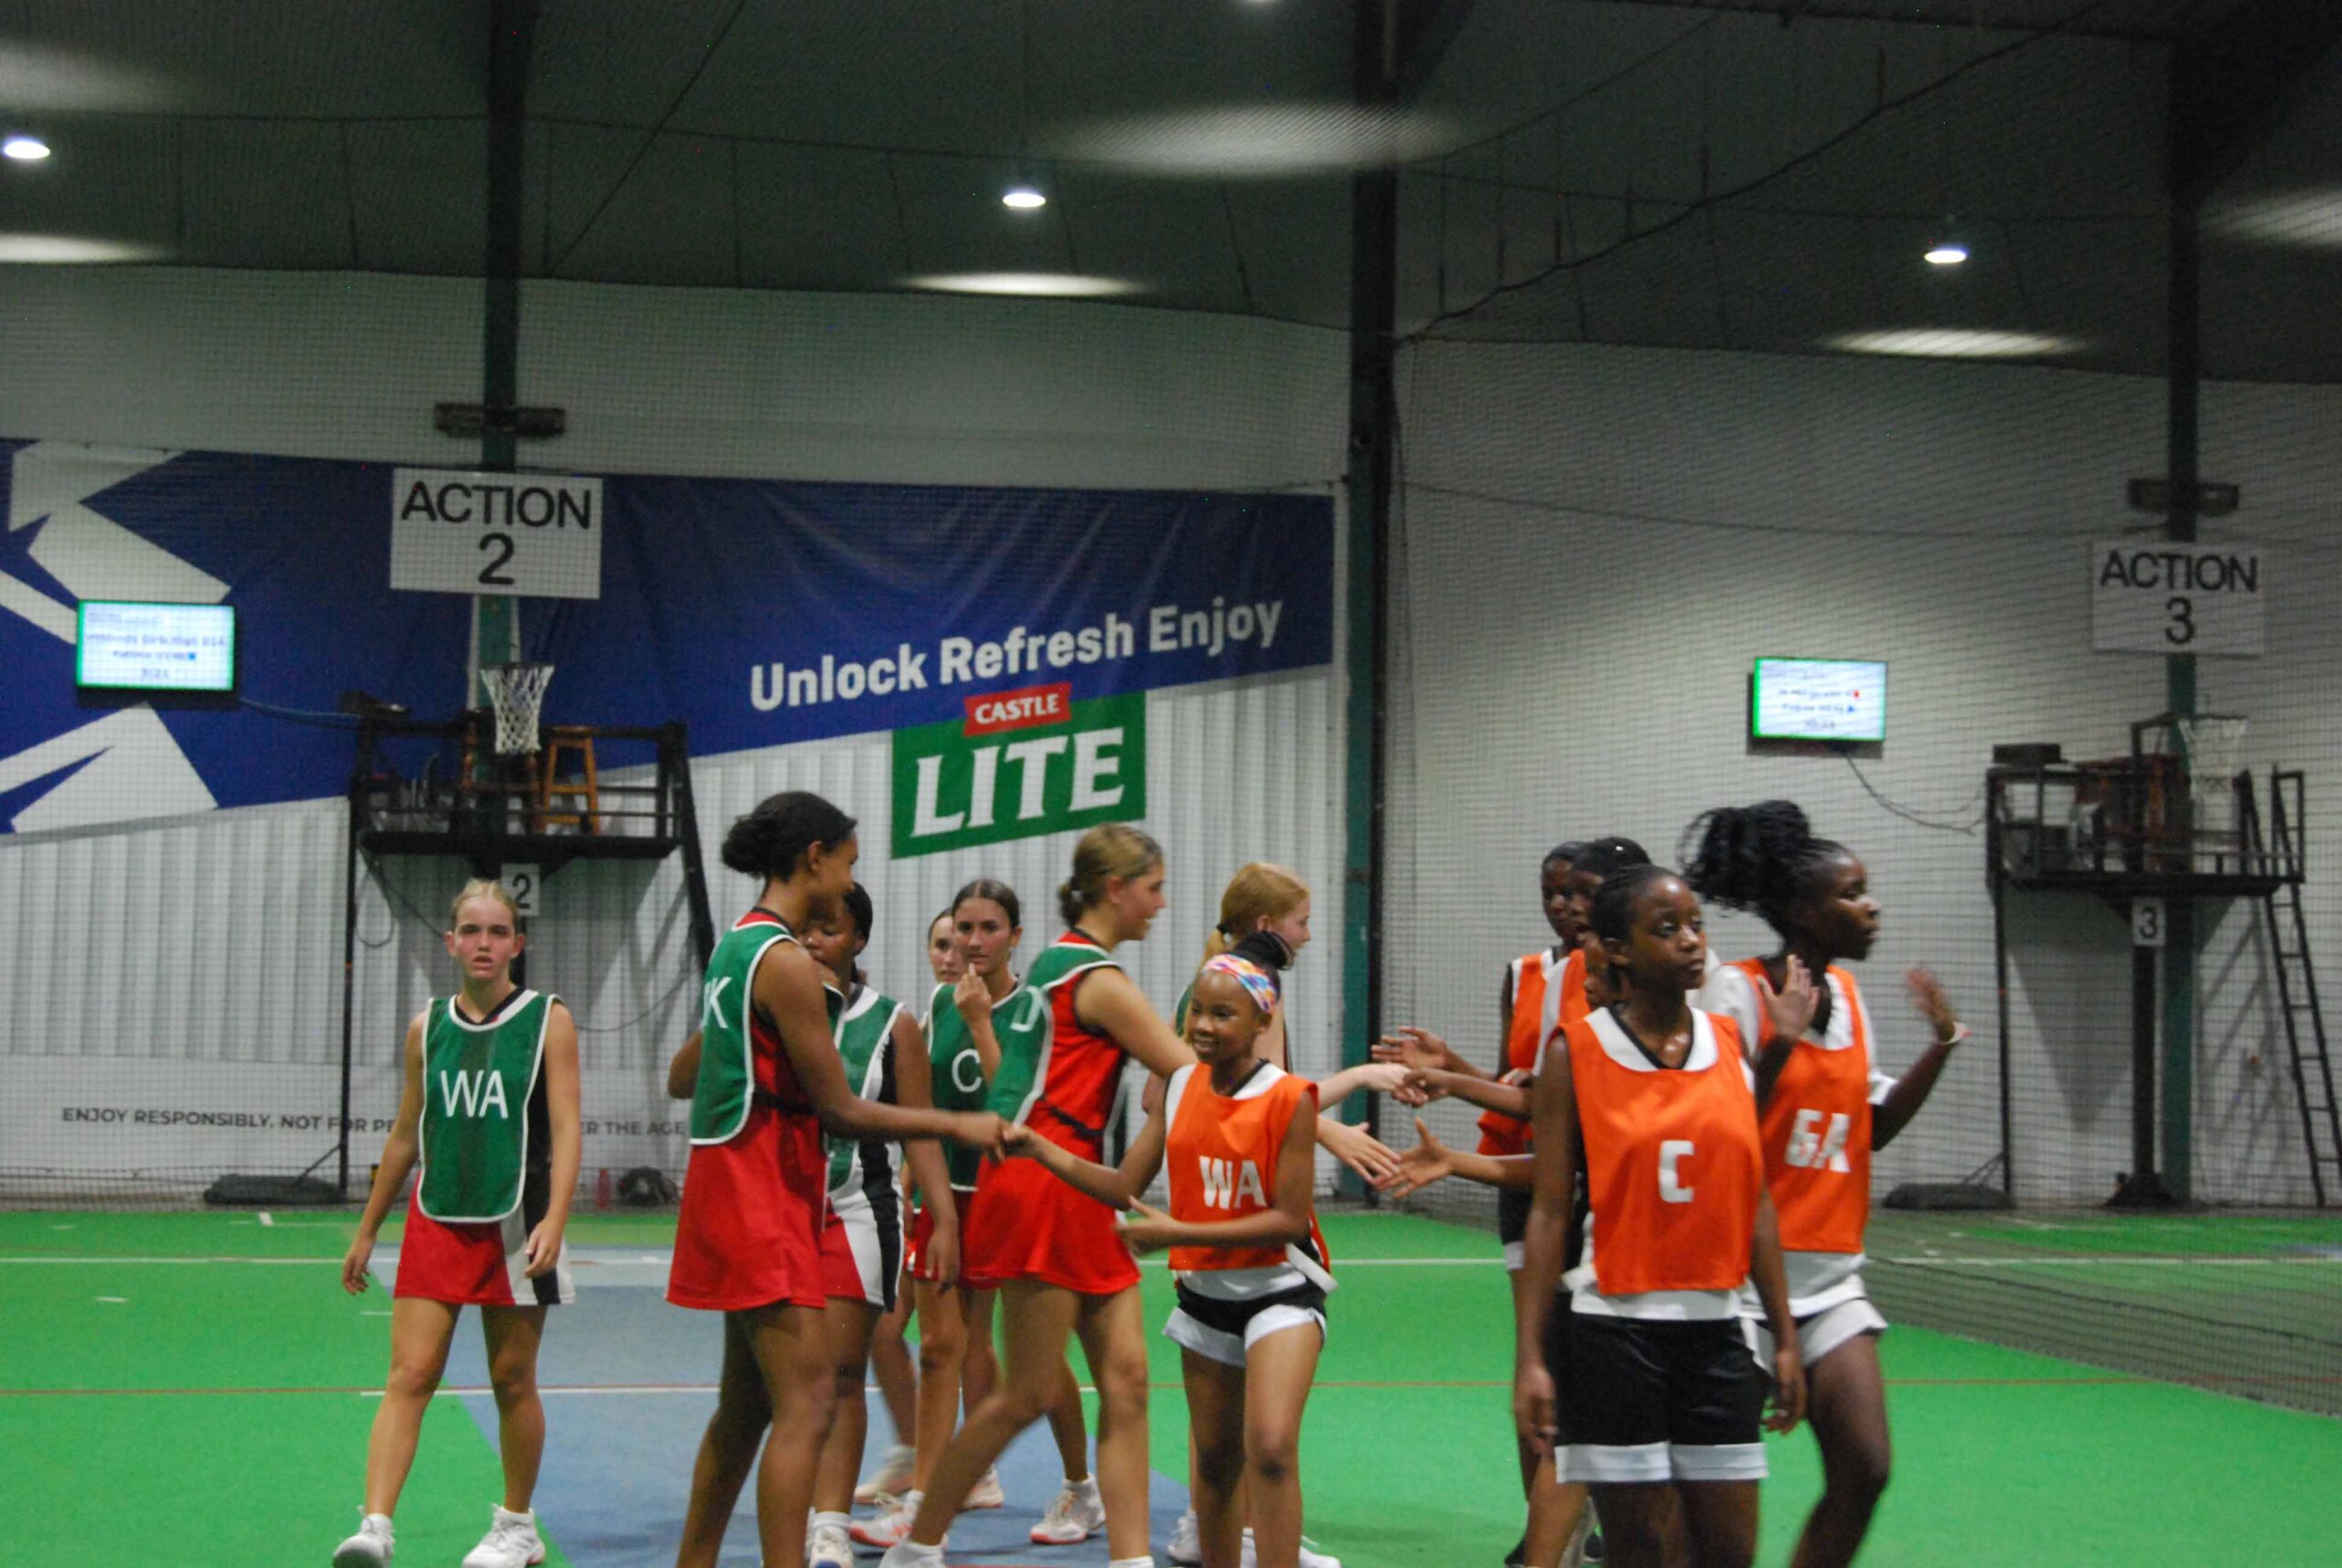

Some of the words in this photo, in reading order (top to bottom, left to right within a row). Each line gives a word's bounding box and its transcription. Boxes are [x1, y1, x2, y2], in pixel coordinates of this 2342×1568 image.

[401, 480, 591, 530] ACTION
[478, 532, 514, 585] 2
[2100, 549, 2257, 592] ACTION
[2165, 596, 2195, 644] 3
[750, 643, 928, 711] Unlock
[940, 612, 1134, 684] Refresh
[1149, 596, 1283, 656] Enjoy
[974, 693, 1059, 725] CASTLE
[908, 726, 1125, 838] LITE
[512, 873, 532, 909] 2
[2140, 906, 2158, 940] 3
[702, 975, 732, 1029] K
[440, 1069, 509, 1120] WA
[952, 1048, 983, 1092] C
[61, 1107, 128, 1122] ENJOY
[279, 1114, 322, 1130] NOT
[604, 1121, 642, 1135] THE
[647, 1121, 686, 1135] AGE
[1198, 1155, 1267, 1210] WA
[1658, 1140, 1695, 1203] C
